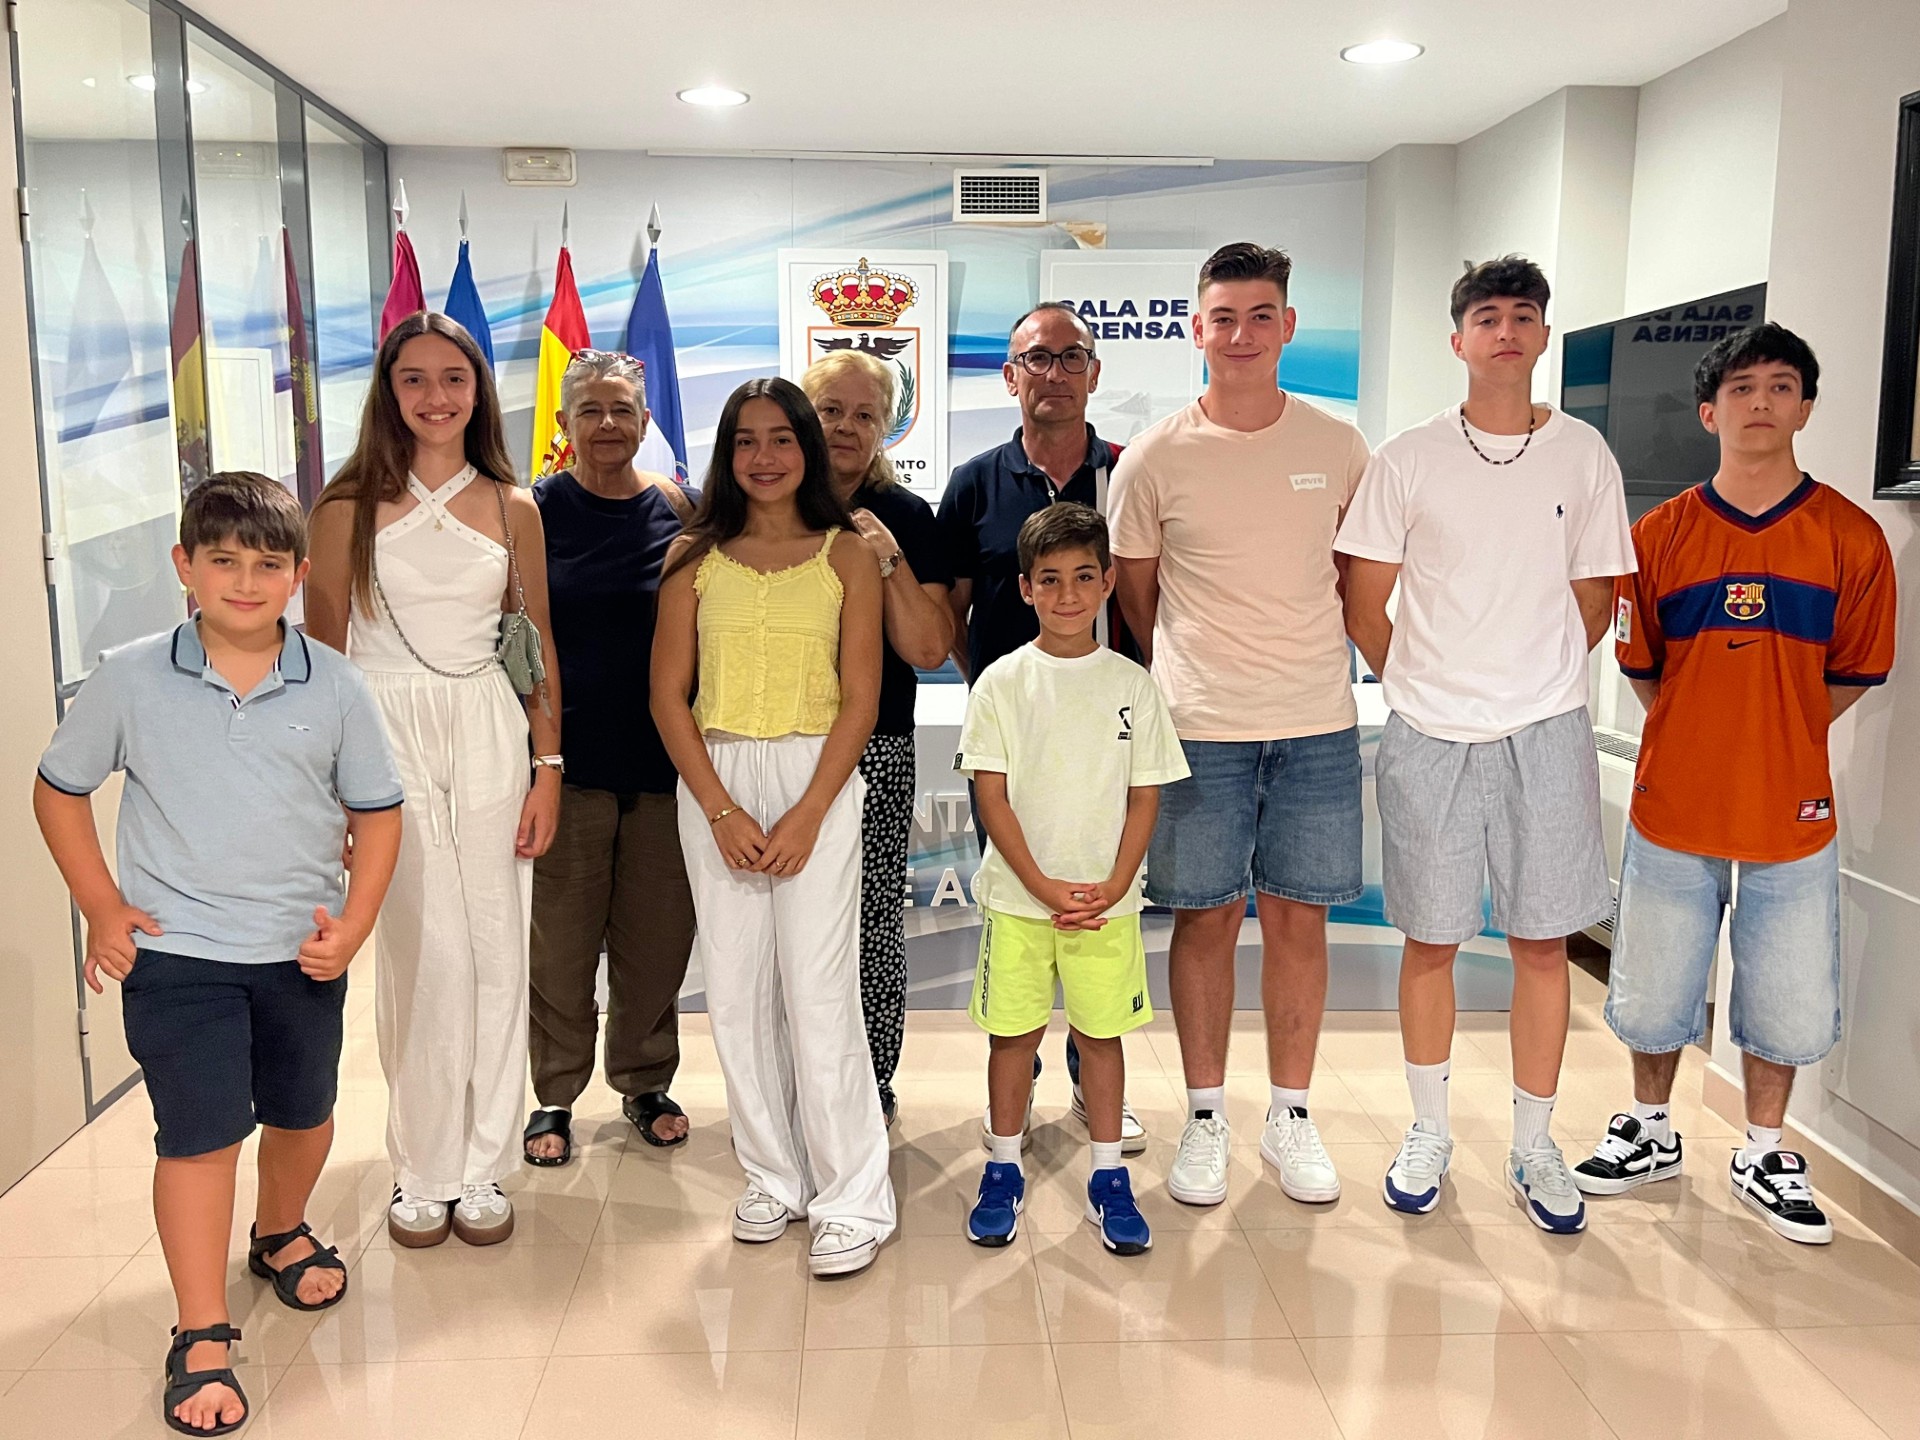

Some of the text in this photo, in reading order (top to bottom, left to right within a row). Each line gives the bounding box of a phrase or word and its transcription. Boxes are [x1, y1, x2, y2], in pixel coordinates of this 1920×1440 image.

[1149, 300, 1189, 317] DE
[1089, 322, 1186, 339] RENSA
[895, 460, 927, 470] NTO
